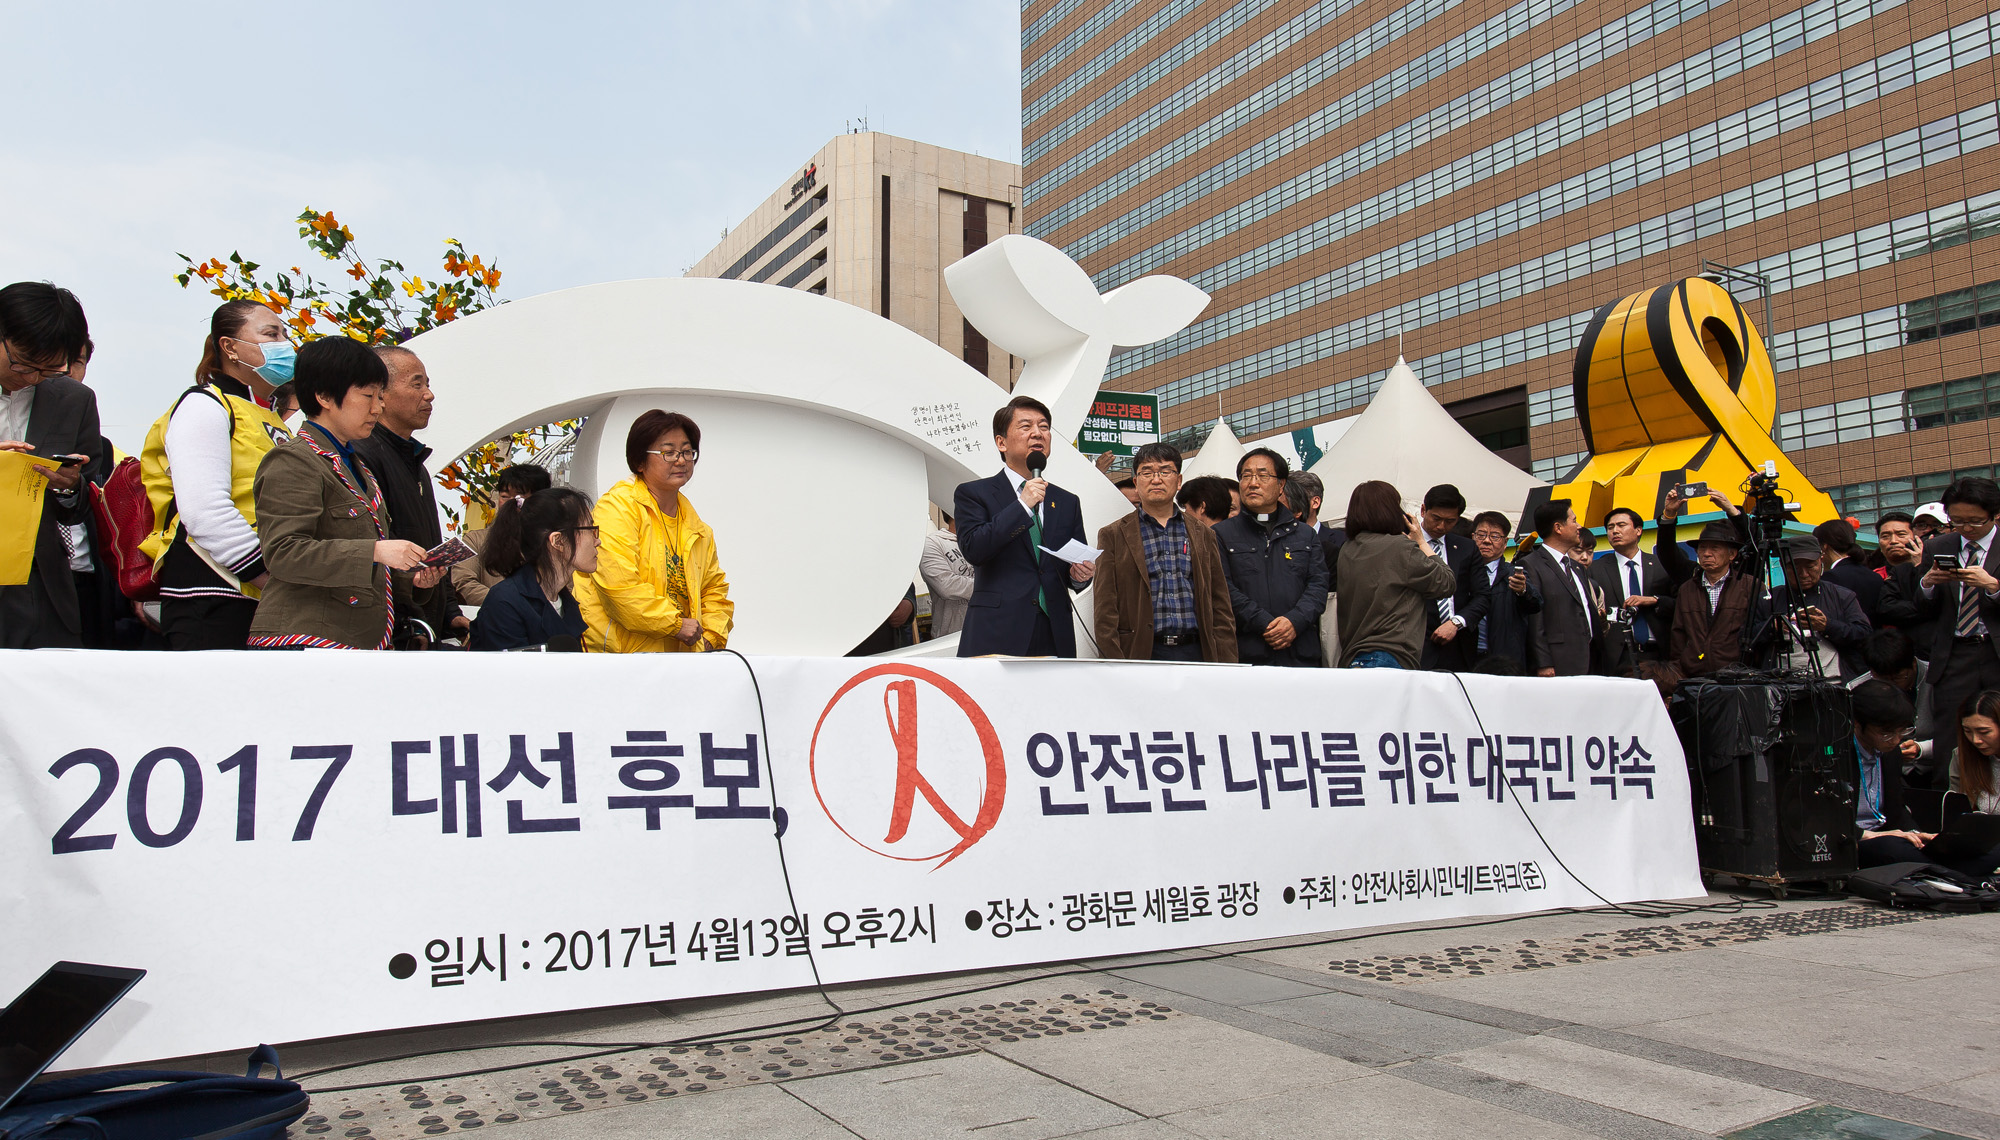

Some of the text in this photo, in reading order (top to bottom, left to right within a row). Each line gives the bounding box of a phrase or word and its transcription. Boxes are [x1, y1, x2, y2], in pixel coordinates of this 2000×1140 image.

[1119, 420, 1153, 432] 대통령은
[1083, 430, 1121, 443] 필요없다!
[48, 731, 1656, 855] 2017 대선 후보, 안전한 나라를 위한 대국민 약속
[1811, 853, 1832, 862] XETEC
[544, 922, 678, 973] 2017년
[687, 912, 811, 964] 4월13일
[822, 904, 937, 951] 오후2시
[1062, 891, 1137, 932] 광화문
[1143, 884, 1213, 926] 세월호
[1217, 881, 1260, 919] 광장
[1351, 860, 1547, 906] 안전사회시민네트워크(준)
